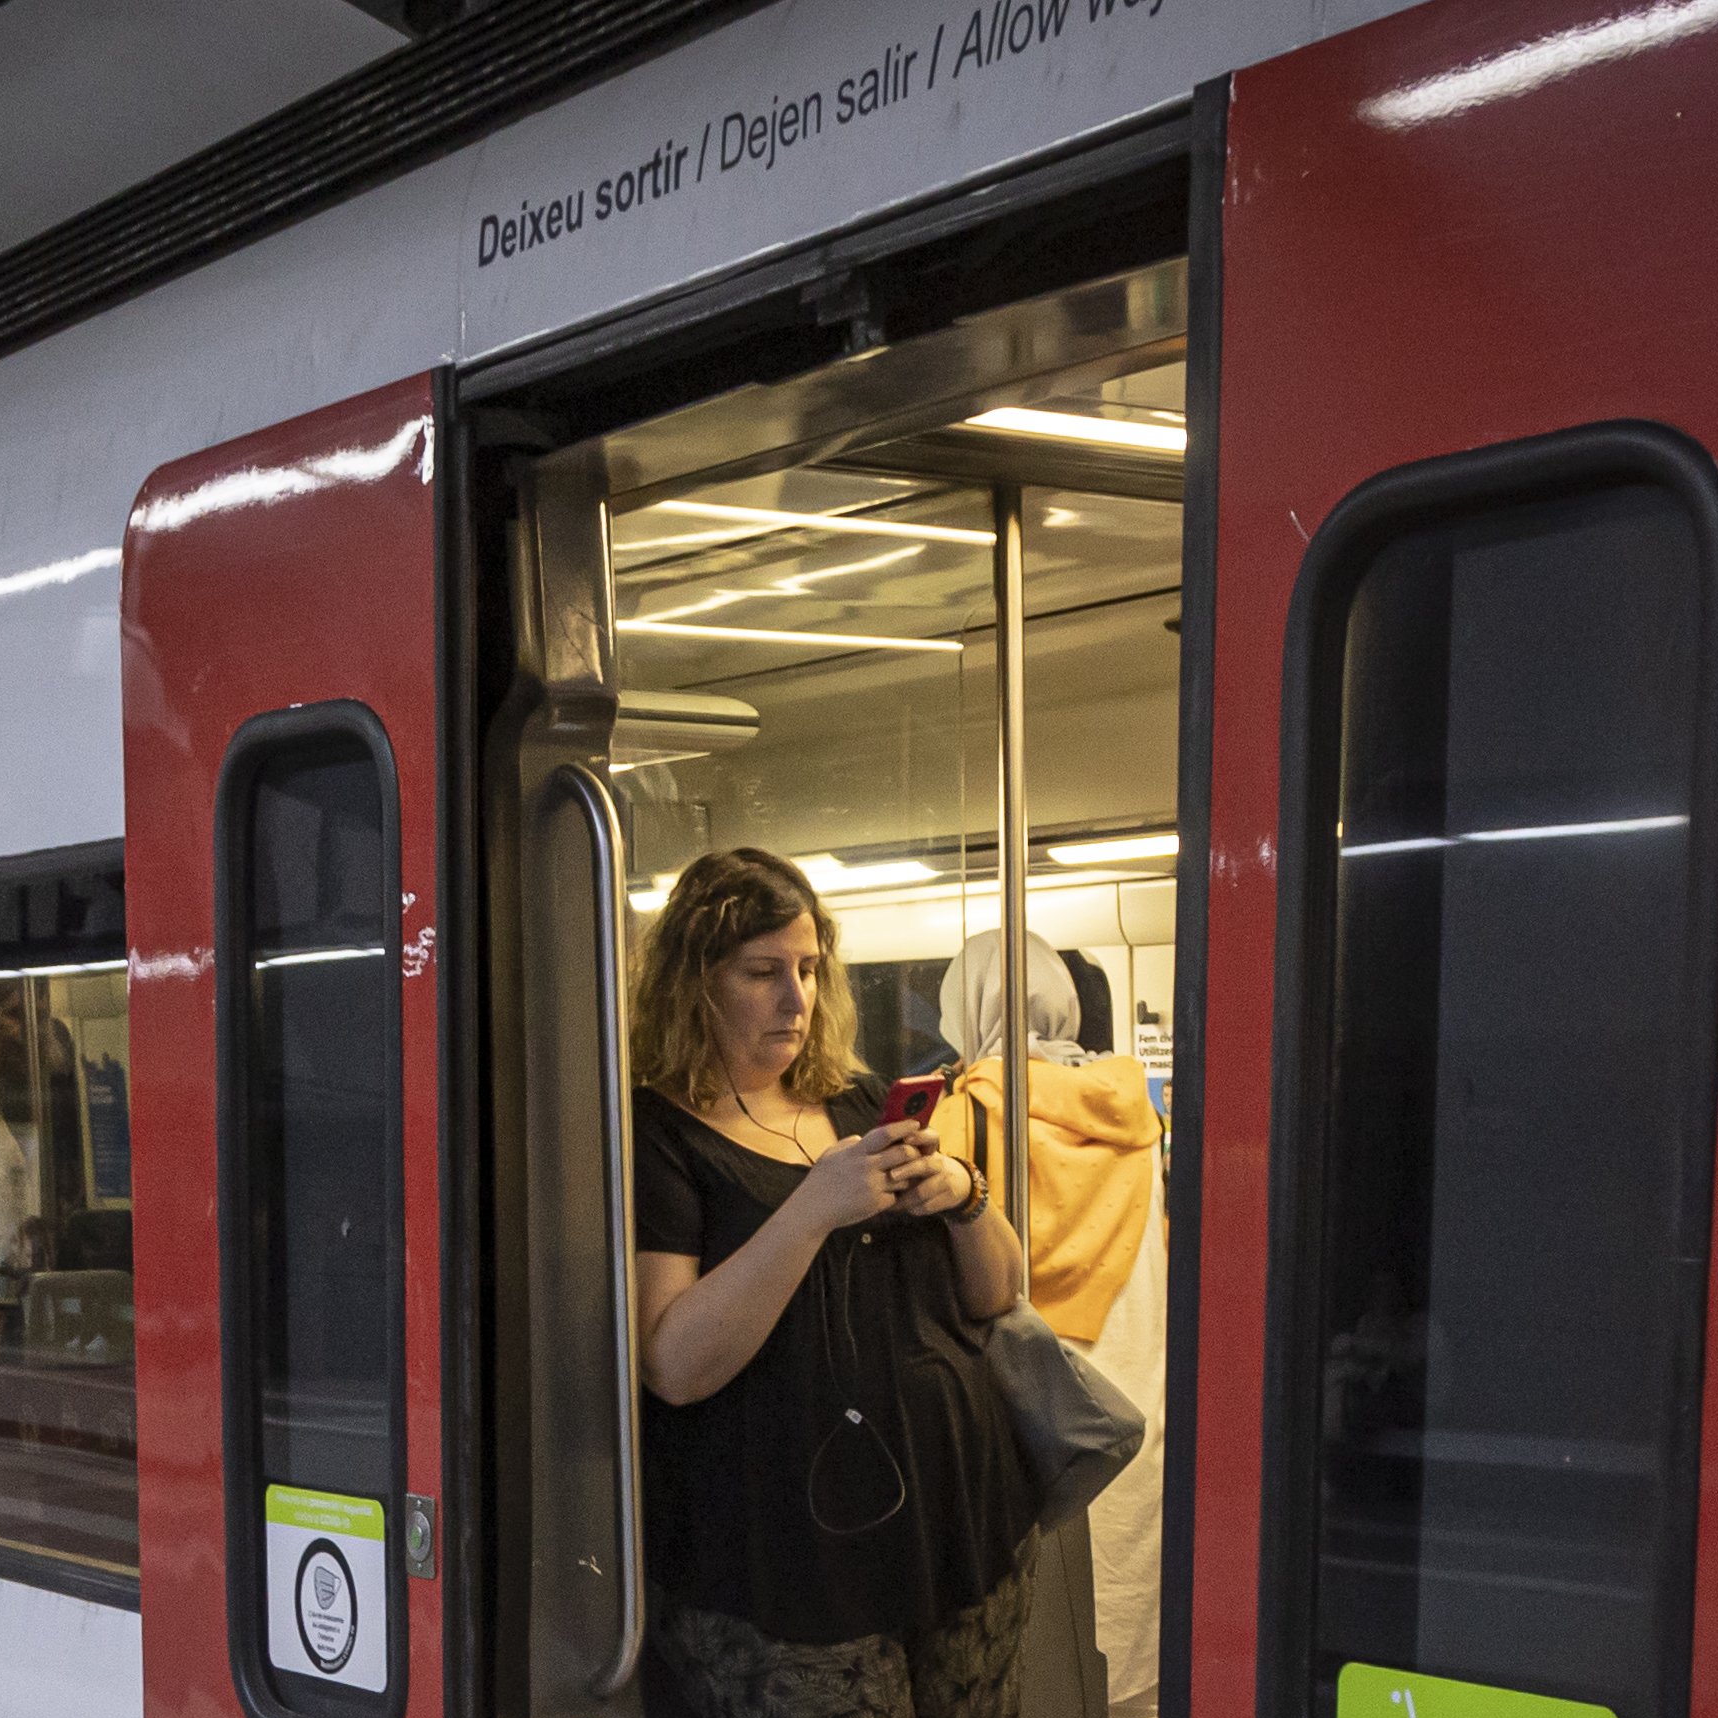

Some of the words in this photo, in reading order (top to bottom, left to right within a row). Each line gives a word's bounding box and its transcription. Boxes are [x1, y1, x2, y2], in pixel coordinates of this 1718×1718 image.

[478, 190, 584, 268] Deixeu
[595, 139, 689, 220] sortir
[720, 91, 823, 172] Dejen
[836, 42, 918, 124] salir
[952, 0, 1071, 79] Allow
